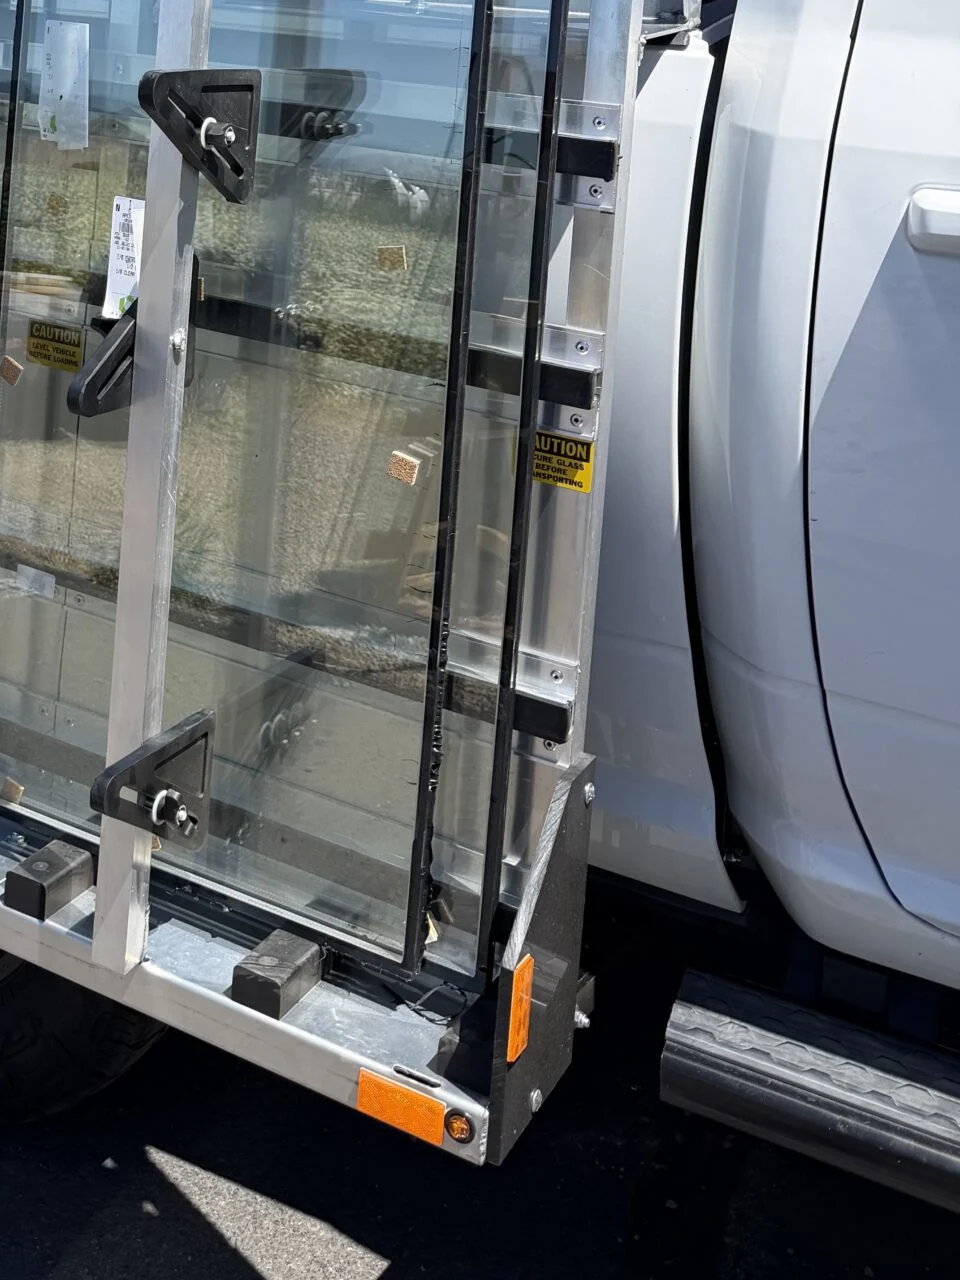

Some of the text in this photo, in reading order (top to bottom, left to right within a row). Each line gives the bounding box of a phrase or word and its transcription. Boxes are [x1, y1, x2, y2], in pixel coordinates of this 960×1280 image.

[32, 323, 79, 345] CAUTION
[52, 345, 76, 358] VEHICLE
[53, 356, 79, 368] LOADING
[535, 434, 587, 460] UTION
[534, 453, 585, 471] URE GLASS
[535, 462, 569, 476] BEFORE
[533, 471, 584, 488] NSPORTING
